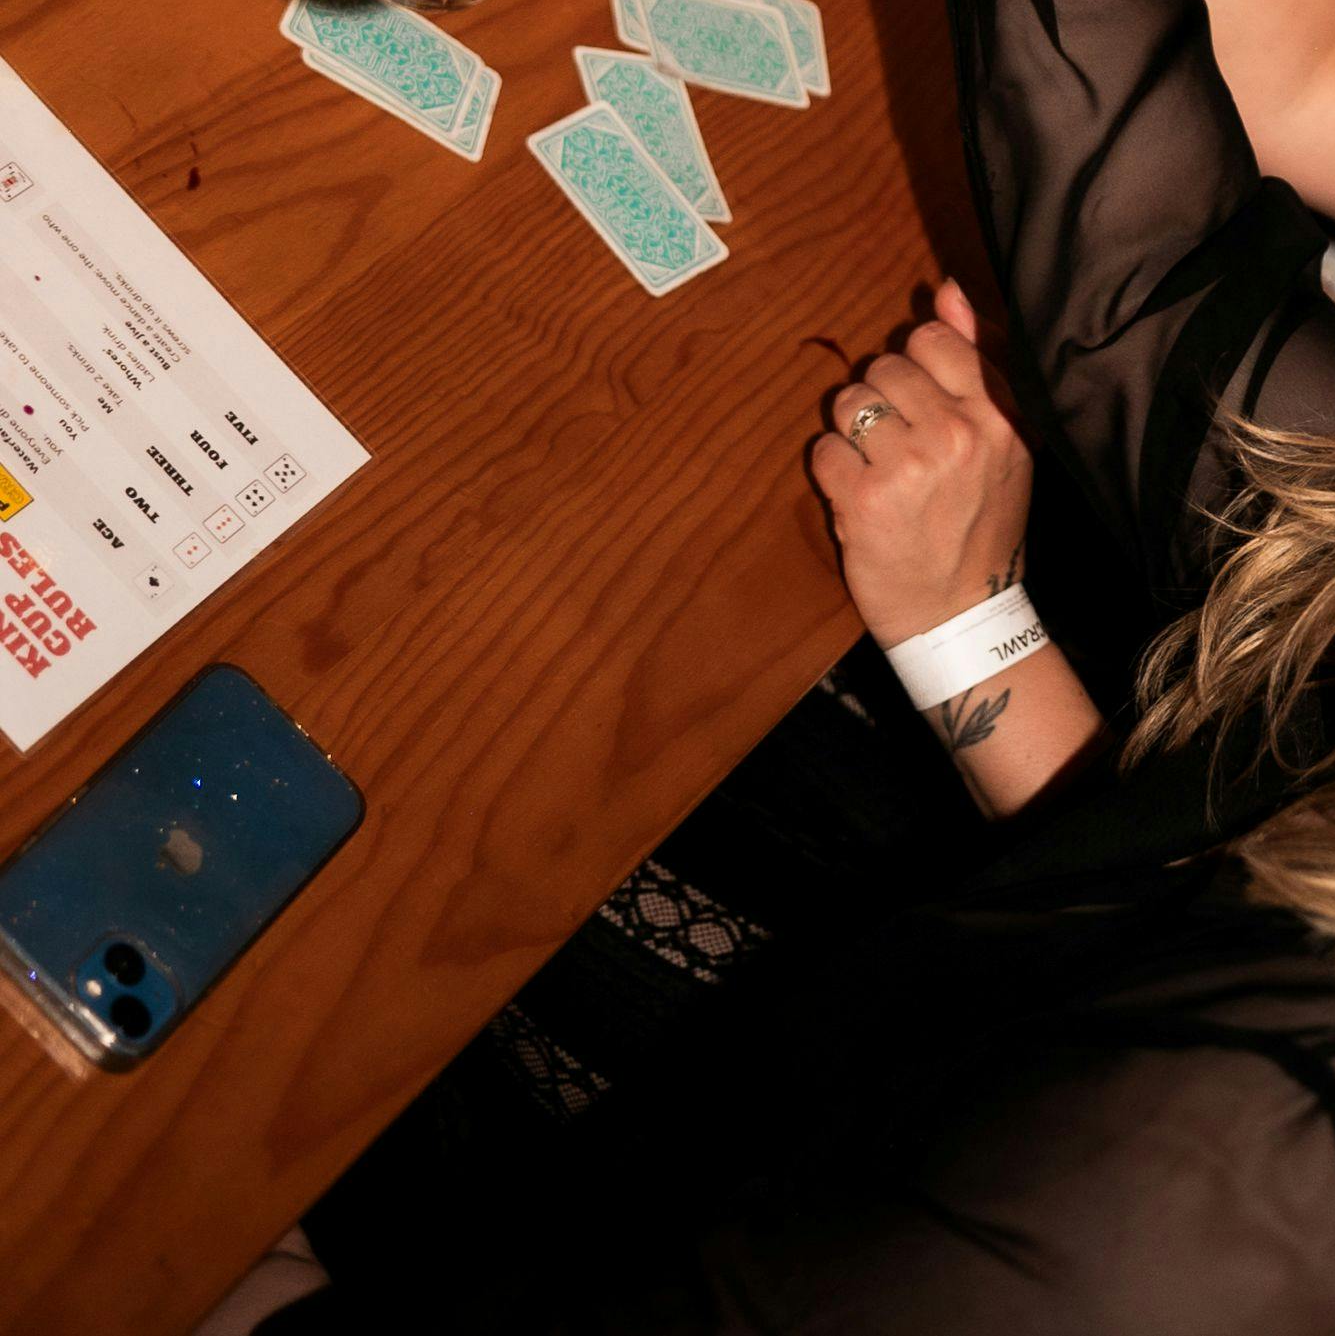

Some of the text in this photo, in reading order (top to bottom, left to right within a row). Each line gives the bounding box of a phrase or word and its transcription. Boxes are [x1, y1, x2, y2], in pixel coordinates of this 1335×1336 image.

[42, 214, 62, 235] who
[61, 235, 79, 253] one
[78, 252, 95, 270] the
[115, 271, 192, 355] screws it up drinks.
[119, 297, 147, 325] dance
[18, 354, 29, 366] to
[124, 320, 171, 371] Bust a Jive
[152, 332, 181, 363] Create
[66, 341, 123, 407] Take 2 drinks.
[125, 351, 156, 383] Ladies
[29, 365, 72, 411] someone
[71, 411, 91, 433] Pick
[97, 397, 114, 414] Me
[9, 415, 51, 466] Everyone
[43, 433, 64, 457] you.
[58, 418, 78, 441] You
[224, 410, 259, 446] FIVE
[0, 425, 39, 475] Waterfa
[190, 429, 229, 470] FOUR
[146, 445, 195, 497] THREE
[125, 486, 160, 524] TWO
[92, 518, 125, 550] ACE
[0, 531, 97, 641] RULES
[5, 593, 72, 657] CUP
